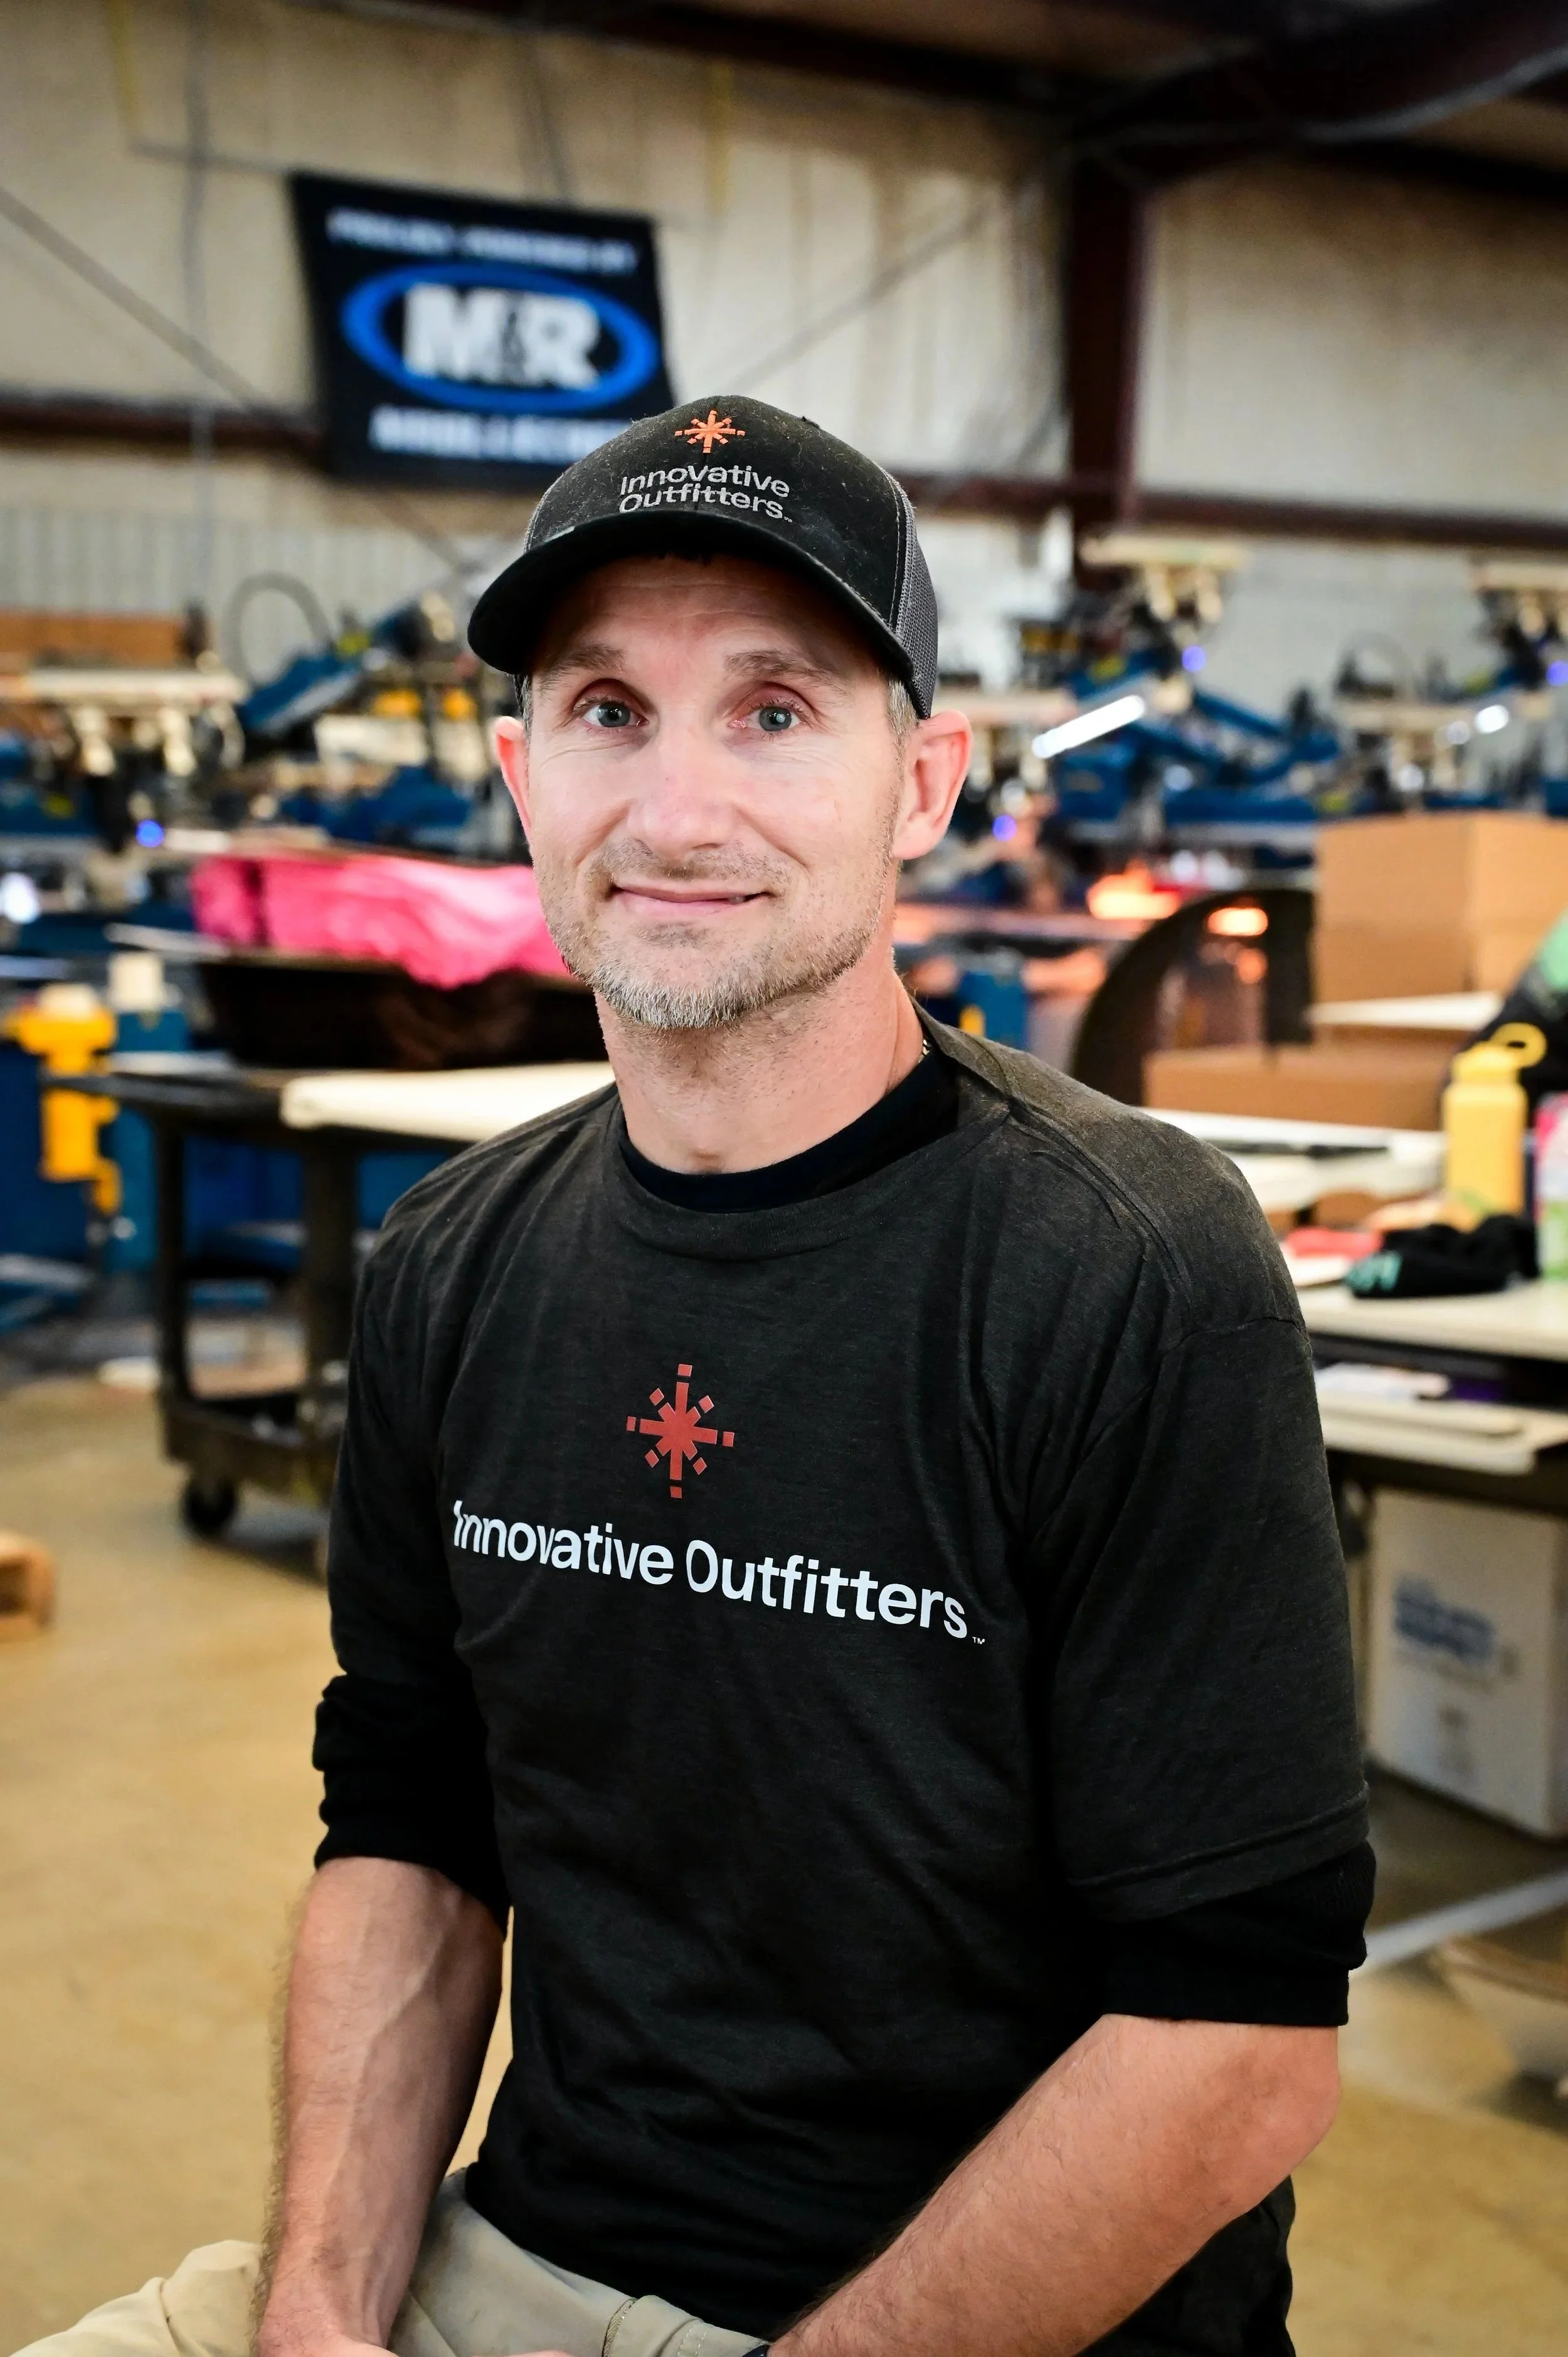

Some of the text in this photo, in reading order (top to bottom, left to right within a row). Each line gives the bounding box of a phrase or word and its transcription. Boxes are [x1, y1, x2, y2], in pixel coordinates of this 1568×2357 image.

[620, 465, 790, 497] Innovative
[619, 483, 783, 519] Outfitters
[453, 1500, 674, 1585] Innovative
[686, 1540, 967, 1639] Outfitters
